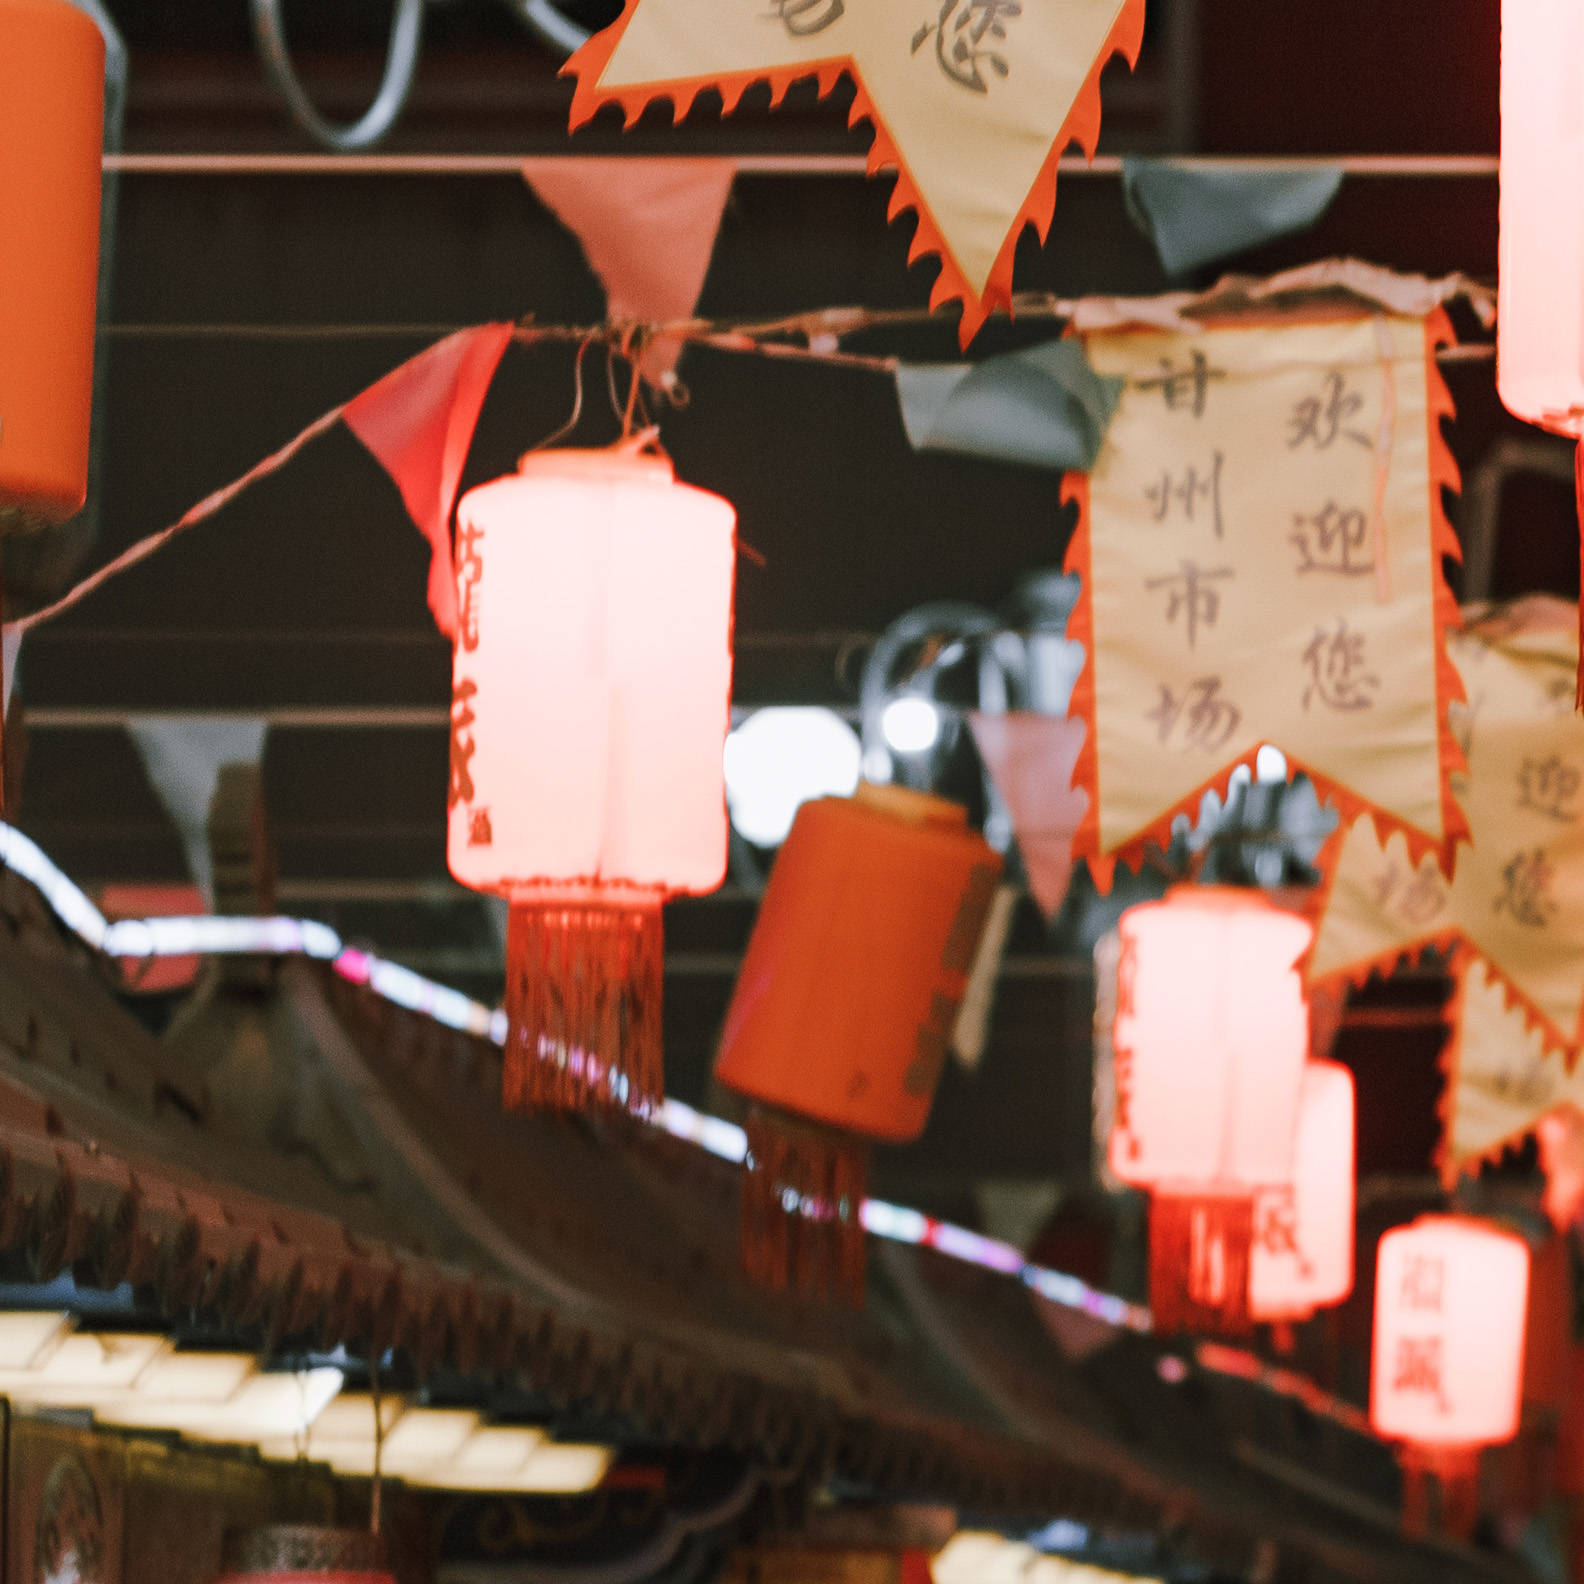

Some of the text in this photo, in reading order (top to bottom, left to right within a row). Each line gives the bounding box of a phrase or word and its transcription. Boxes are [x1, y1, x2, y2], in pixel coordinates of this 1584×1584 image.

[1136, 346, 1241, 755] 甘州市场
[1286, 370, 1380, 713] 欢迎您
